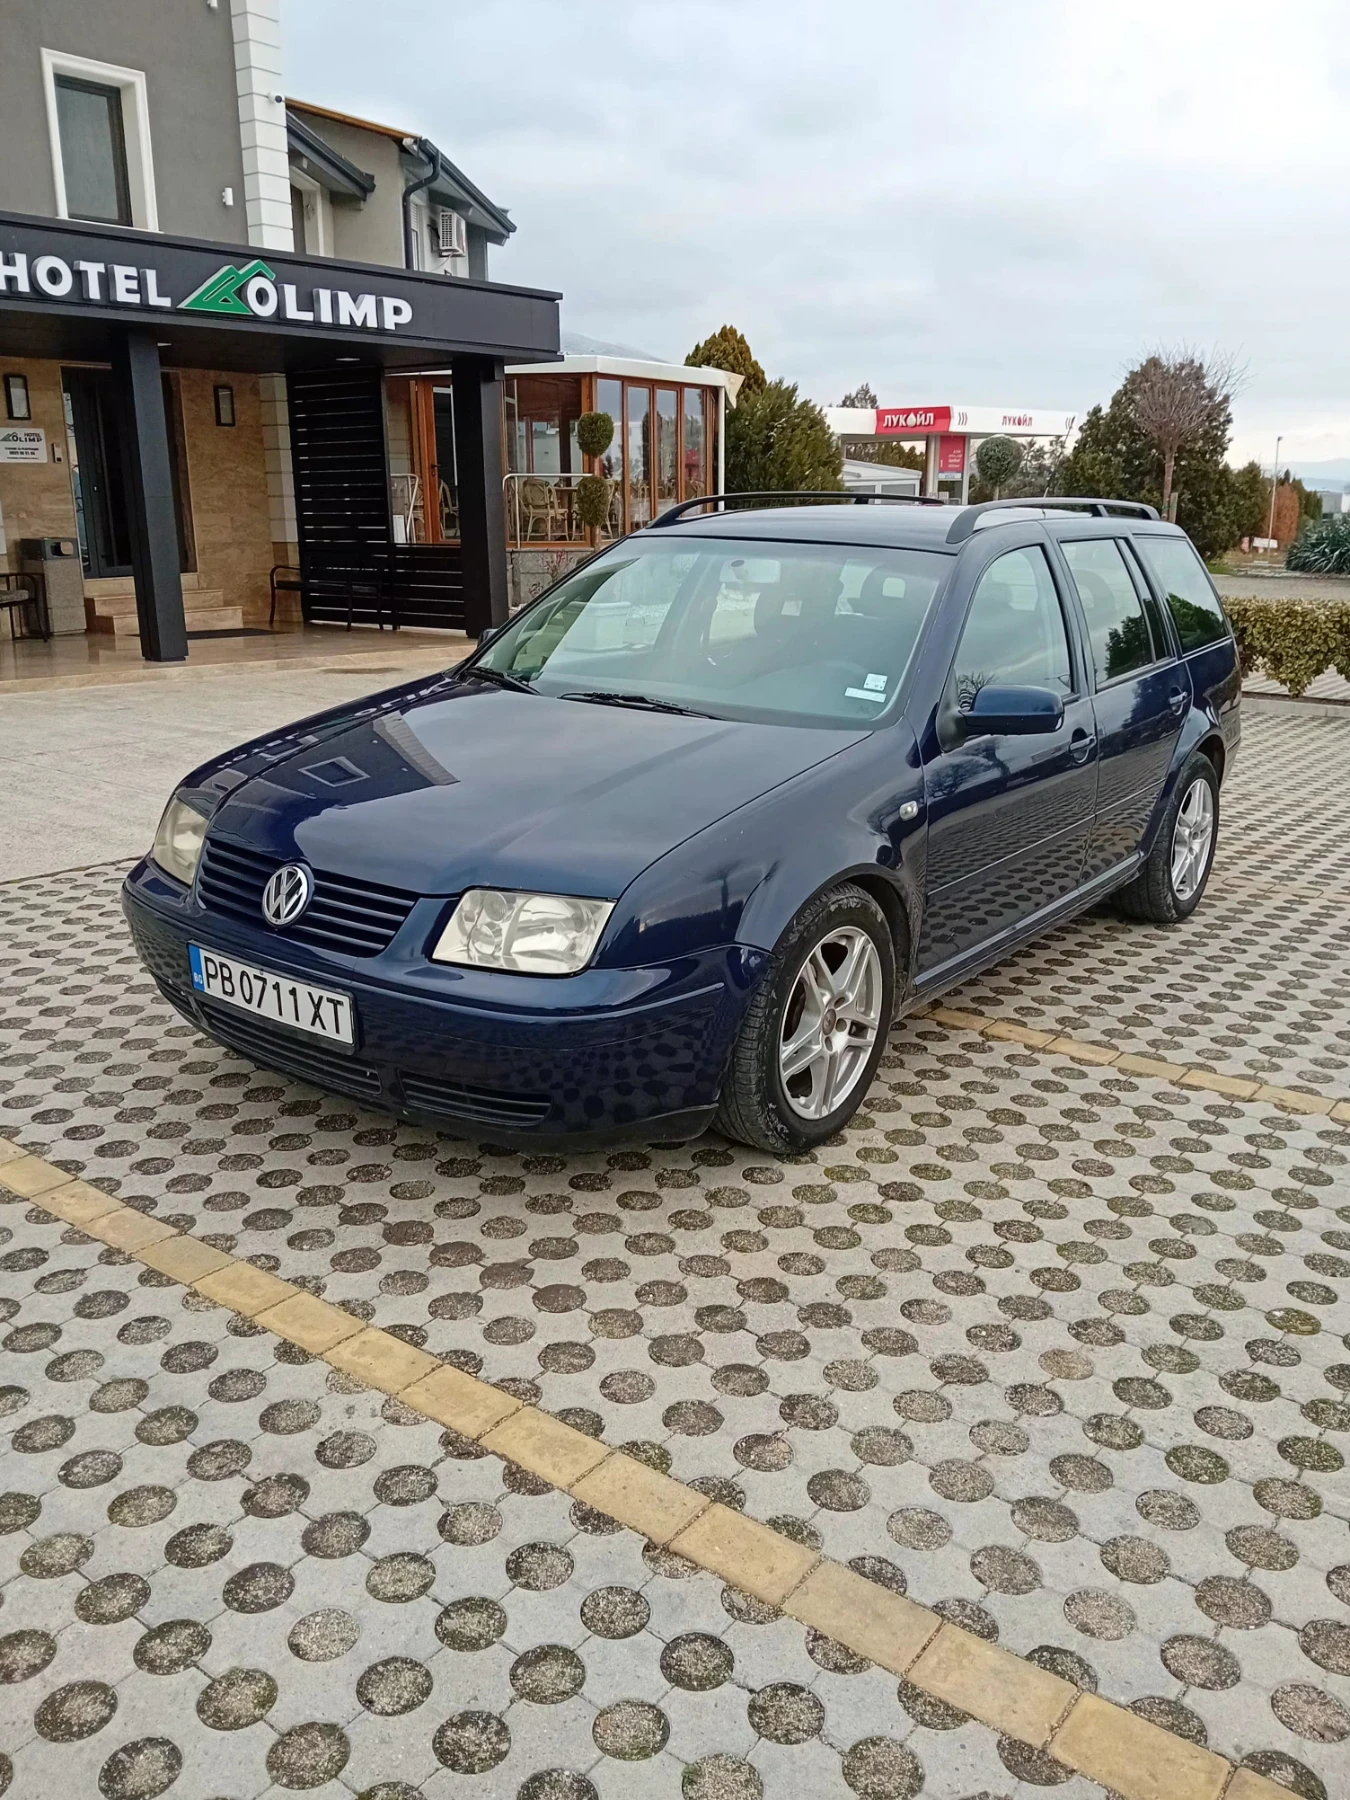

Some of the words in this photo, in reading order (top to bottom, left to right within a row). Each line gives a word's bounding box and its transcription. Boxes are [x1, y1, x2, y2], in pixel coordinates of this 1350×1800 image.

[0, 250, 171, 307] HOTEL
[246, 276, 413, 330] OLIMP
[883, 410, 935, 428] ЛУКОЙЛ
[1001, 413, 1033, 427] ЛУКОЙЛ
[12, 434, 42, 442] OLIMP
